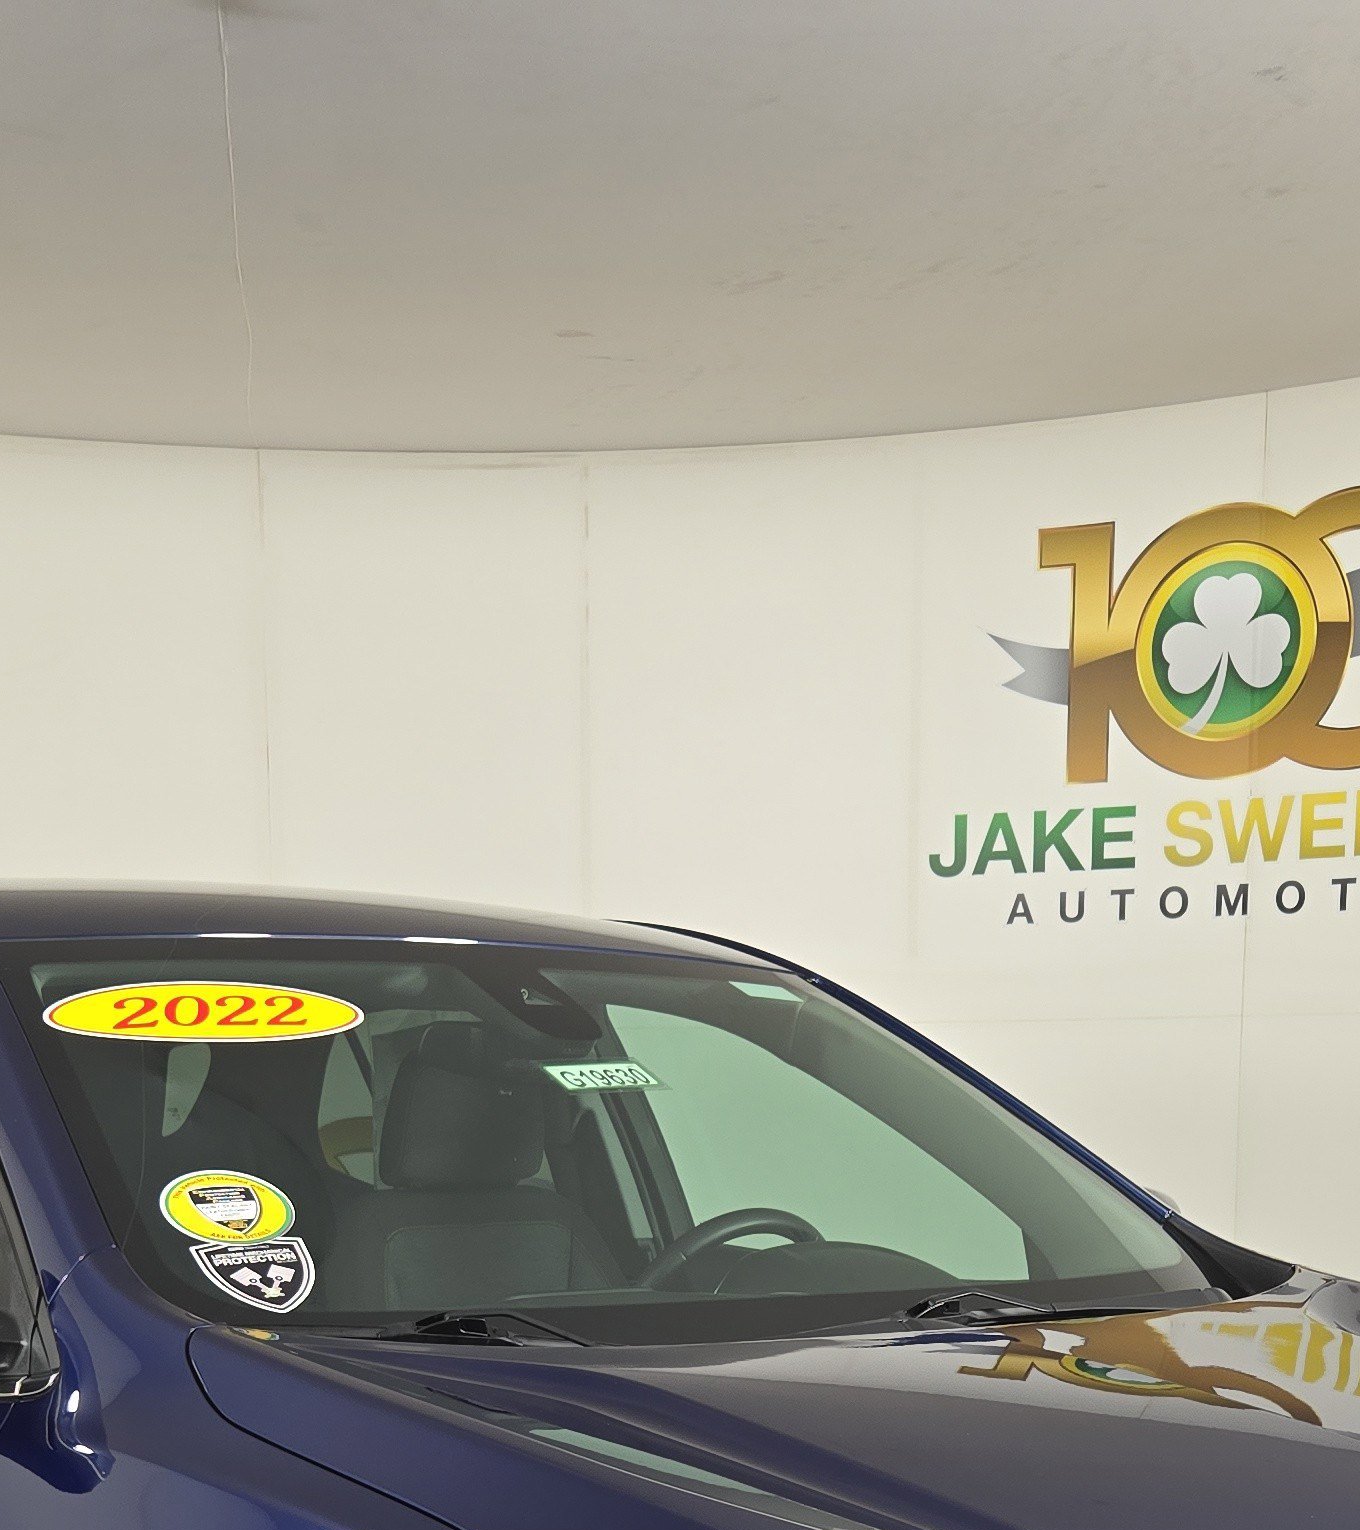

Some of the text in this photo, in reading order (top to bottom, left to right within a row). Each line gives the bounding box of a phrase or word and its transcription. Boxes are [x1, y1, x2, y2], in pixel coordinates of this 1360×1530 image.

[928, 804, 1137, 877] JAKE
[113, 995, 307, 1029] 2022
[560, 1068, 650, 1087] G19630
[213, 1252, 297, 1266] PROTECTION
